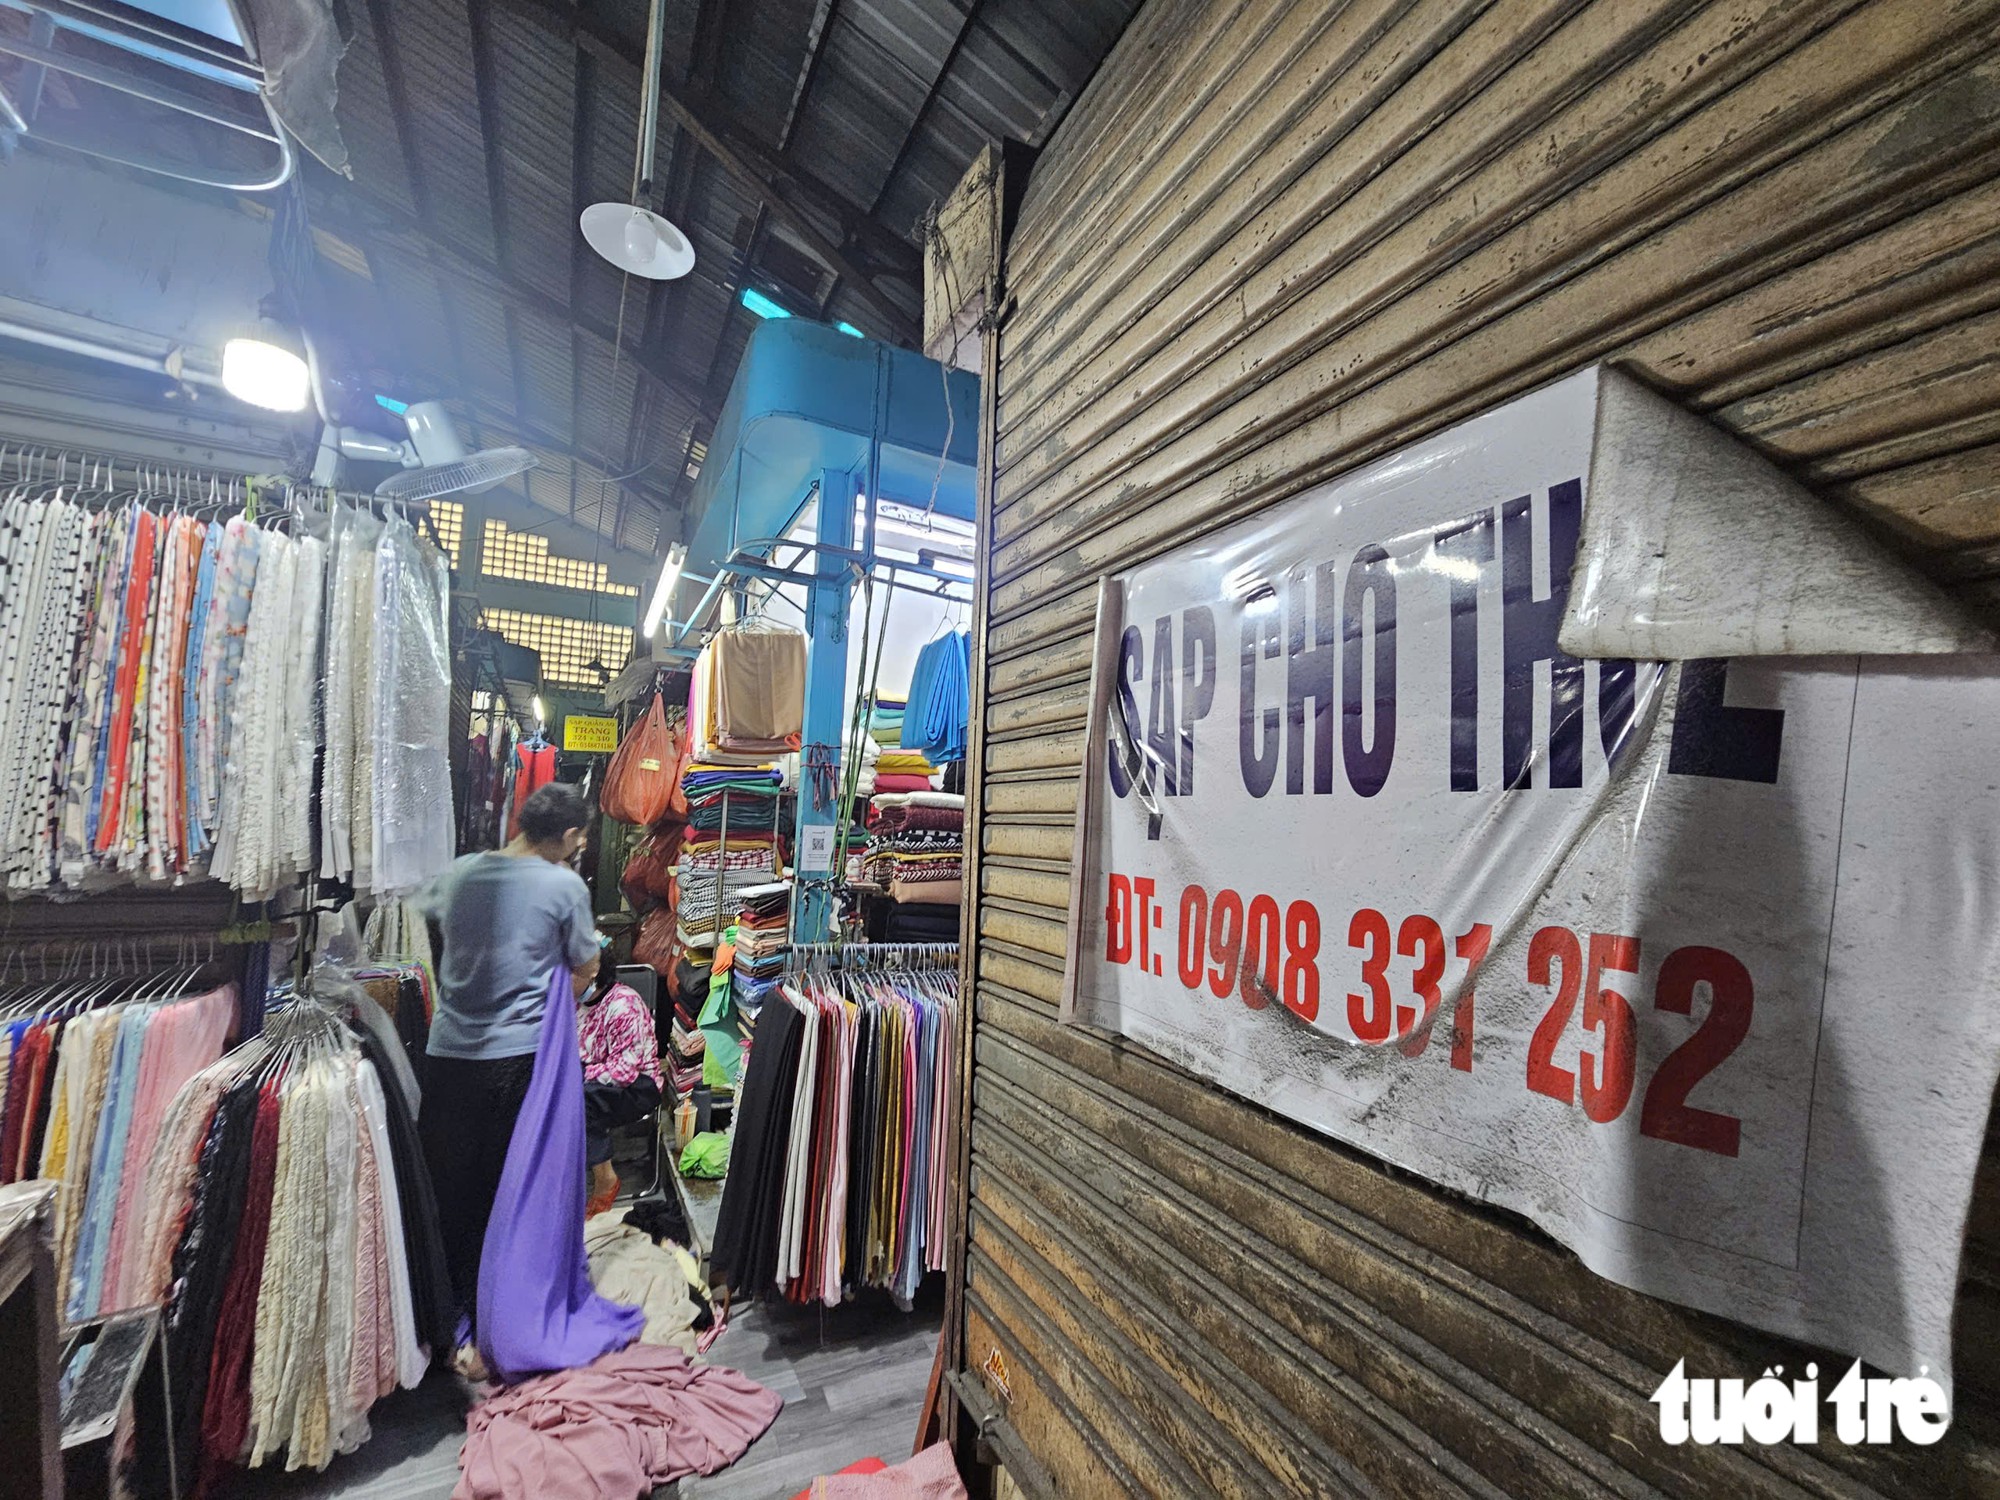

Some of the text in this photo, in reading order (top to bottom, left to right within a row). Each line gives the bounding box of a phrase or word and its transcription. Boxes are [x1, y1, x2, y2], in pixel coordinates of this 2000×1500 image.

[573, 726, 610, 735] TRANG
[1109, 477, 1785, 840] SẠP CHO TH
[1105, 873, 1755, 1159] ĐT: 0908 331 252
